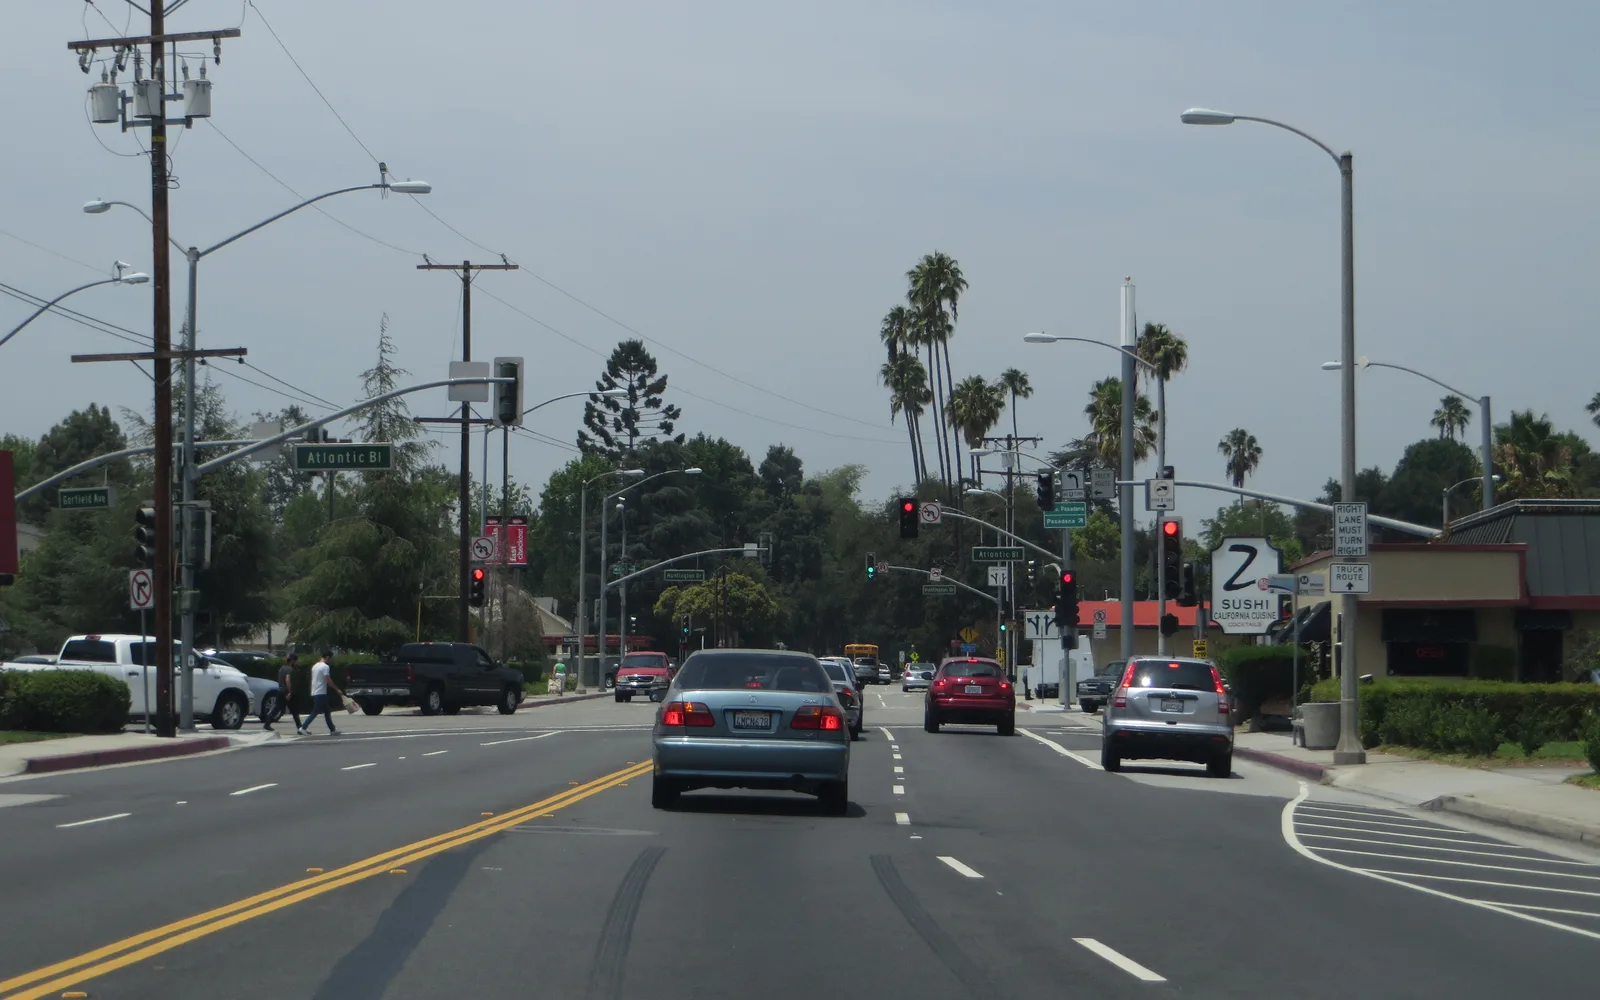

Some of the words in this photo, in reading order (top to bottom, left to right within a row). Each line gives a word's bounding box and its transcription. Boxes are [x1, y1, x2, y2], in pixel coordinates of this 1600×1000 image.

[307, 451, 365, 464] Atlantic
[369, 451, 381, 463] Bl
[1337, 505, 1362, 513] RIGHT
[1338, 516, 1362, 524] LANE
[1339, 526, 1361, 534] MUST
[1339, 536, 1362, 544] TURN
[1222, 544, 1258, 591] Z
[1336, 573, 1363, 581] ROUTE
[1221, 599, 1269, 610] SUSHI
[1213, 612, 1250, 620] CALIFORNIA
[1251, 611, 1276, 619] CUISINE
